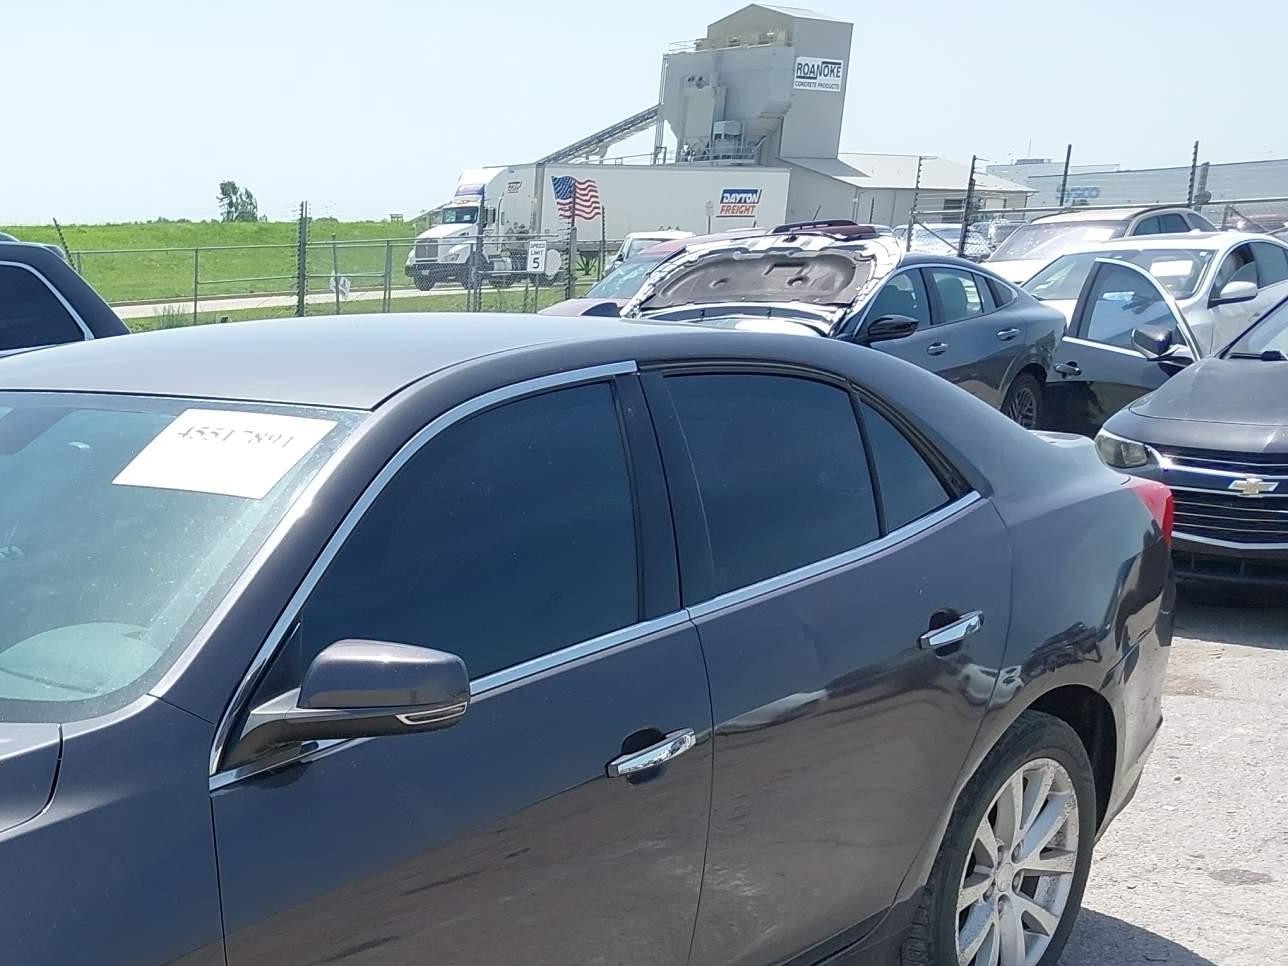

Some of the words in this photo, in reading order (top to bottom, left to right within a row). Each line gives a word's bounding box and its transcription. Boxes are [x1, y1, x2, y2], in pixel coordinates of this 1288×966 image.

[796, 61, 841, 79] ROANOKE
[722, 193, 760, 203] DAYTON
[720, 205, 756, 215] FREIGHT
[532, 257, 540, 269] 5
